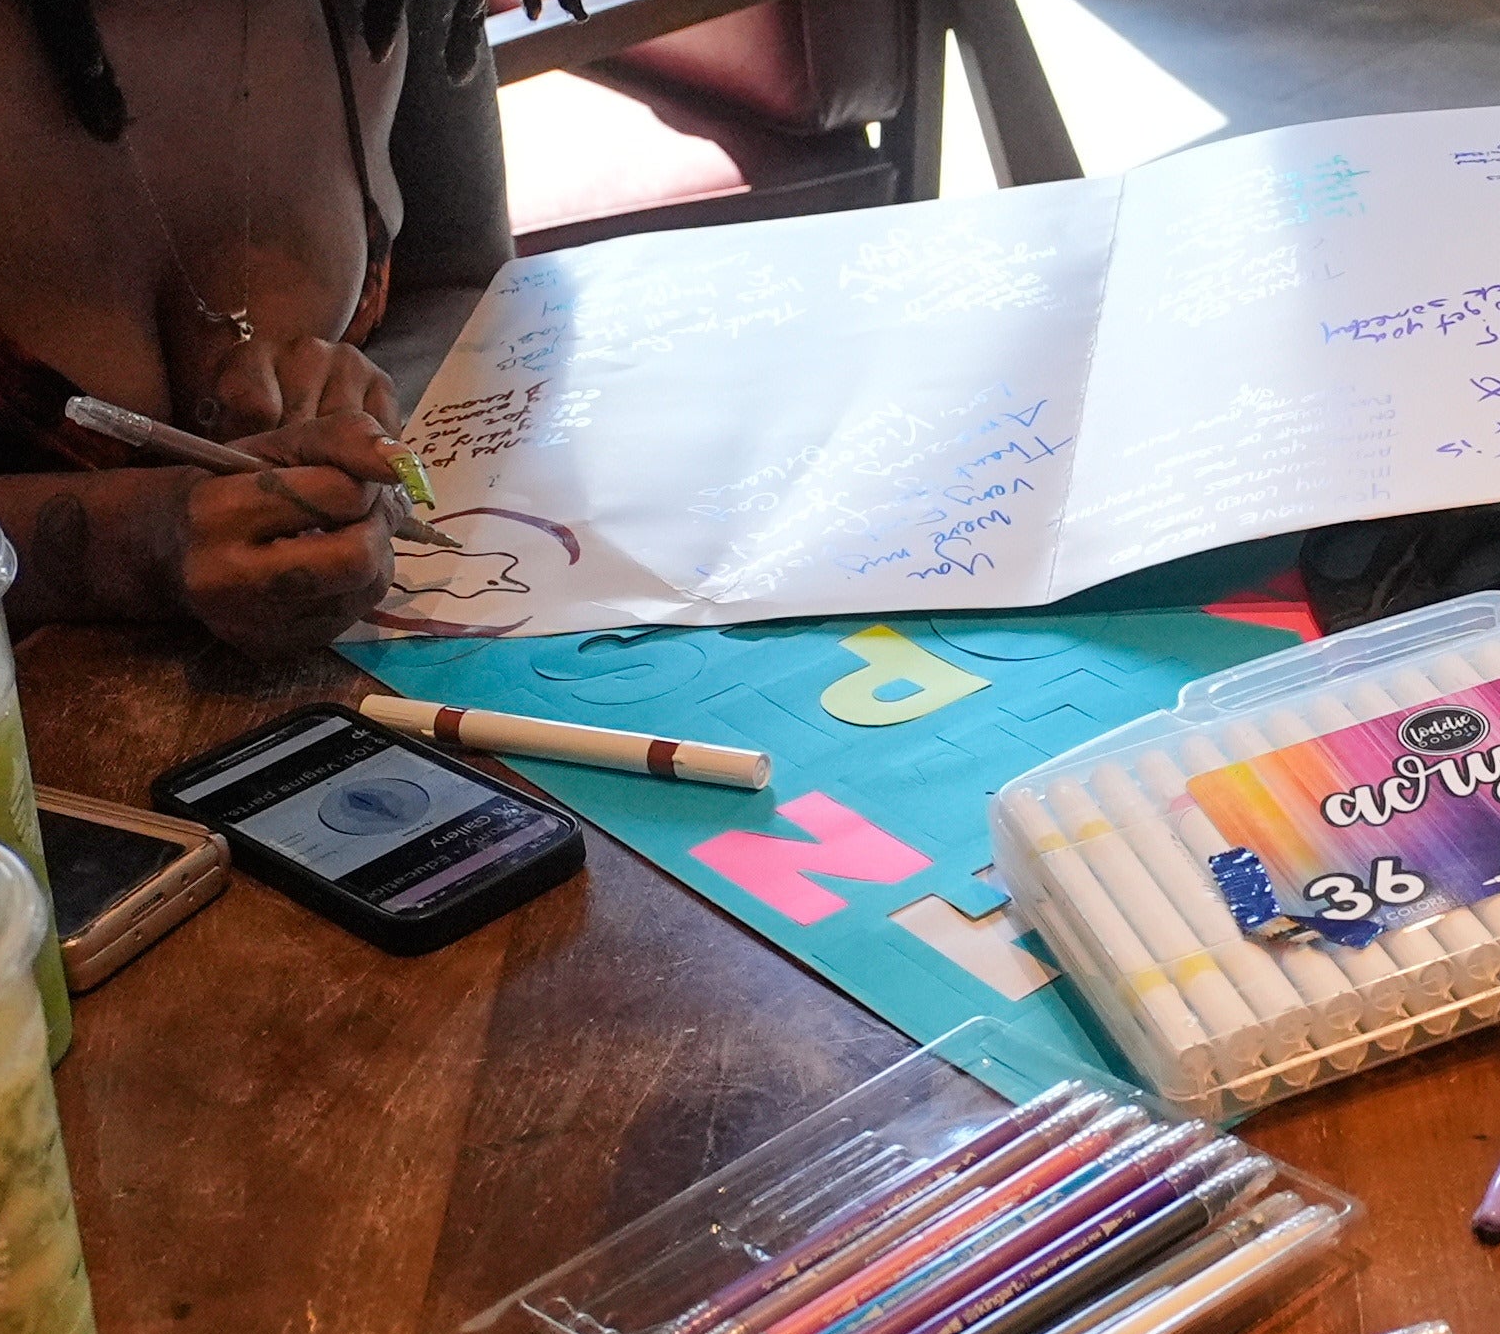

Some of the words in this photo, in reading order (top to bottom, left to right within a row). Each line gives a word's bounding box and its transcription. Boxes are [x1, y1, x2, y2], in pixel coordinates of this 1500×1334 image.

[1438, 302, 1481, 335] get
[955, 436, 1073, 480] Thank
[1306, 857, 1426, 922] 36
